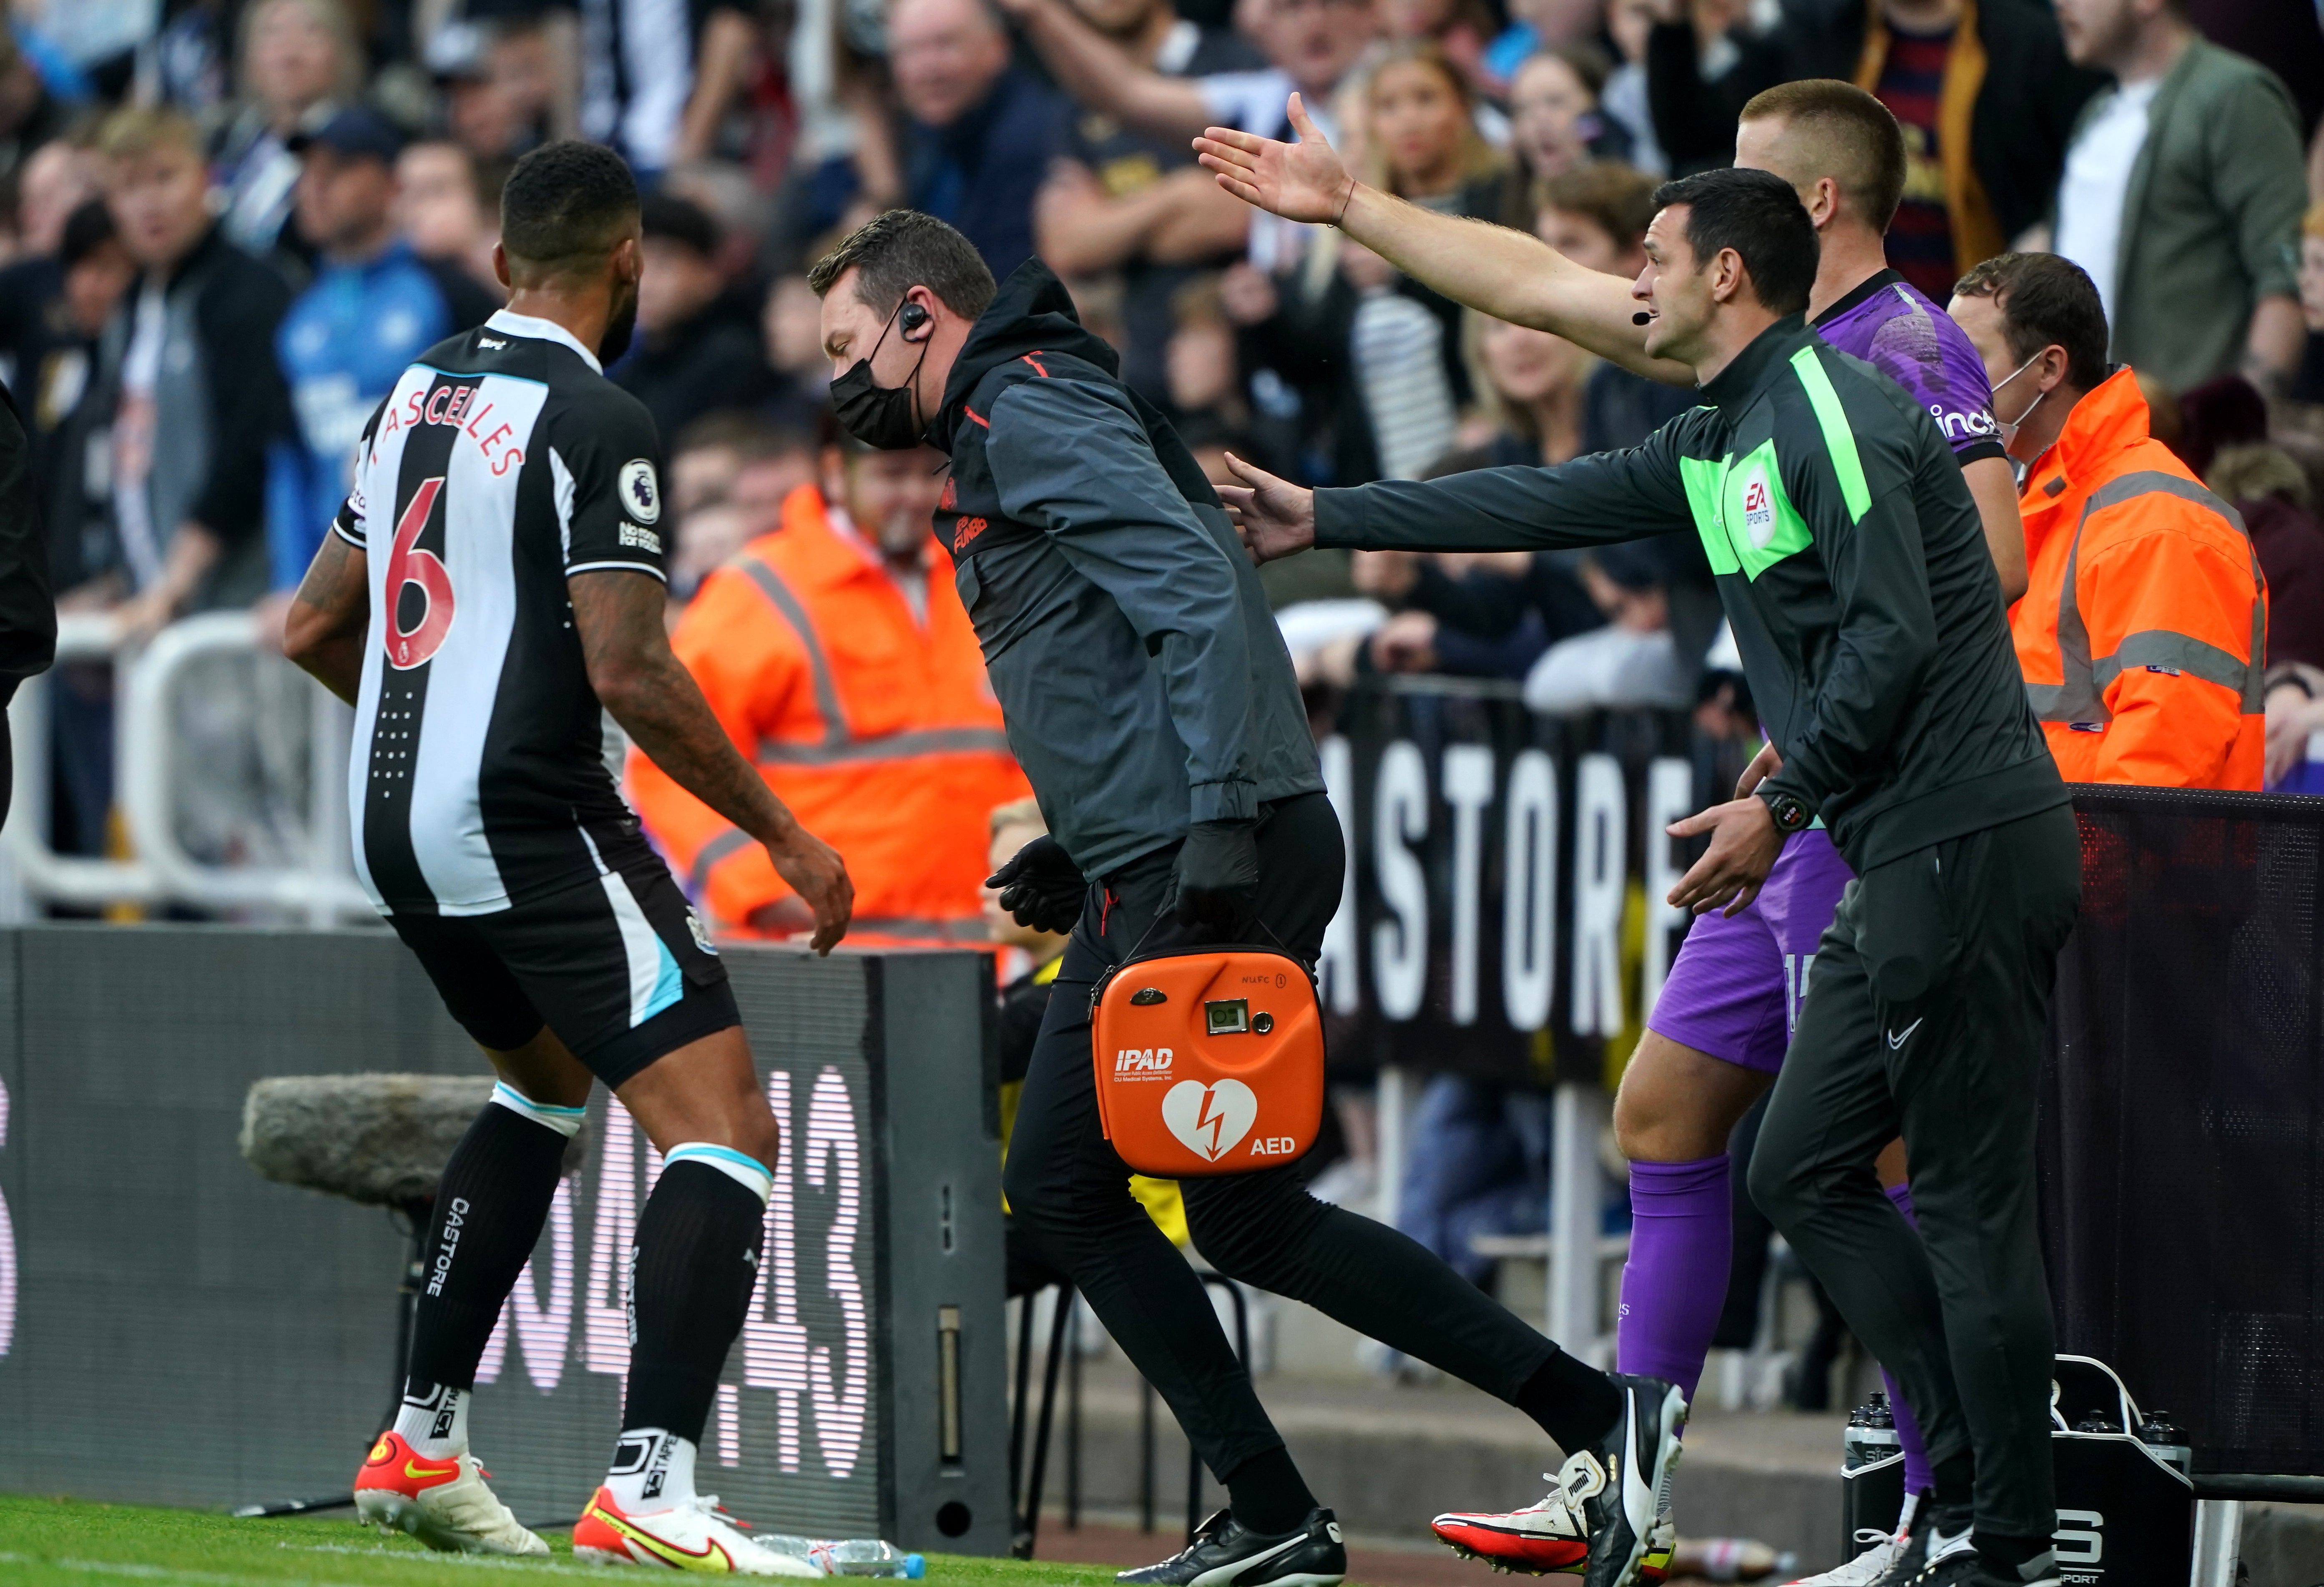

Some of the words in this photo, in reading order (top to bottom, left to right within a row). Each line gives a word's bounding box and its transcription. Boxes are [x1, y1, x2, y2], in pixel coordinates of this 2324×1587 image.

[372, 385, 526, 478] ASCELLES
[1746, 483, 1767, 512] EA
[1746, 510, 1770, 526] SPORTS
[385, 476, 455, 670] 6
[1115, 1048, 1173, 1071] IPAD
[1250, 1137, 1295, 1155] AED
[427, 1197, 470, 1297] CASTORE
[1568, 1474, 1589, 1497] PUMA
